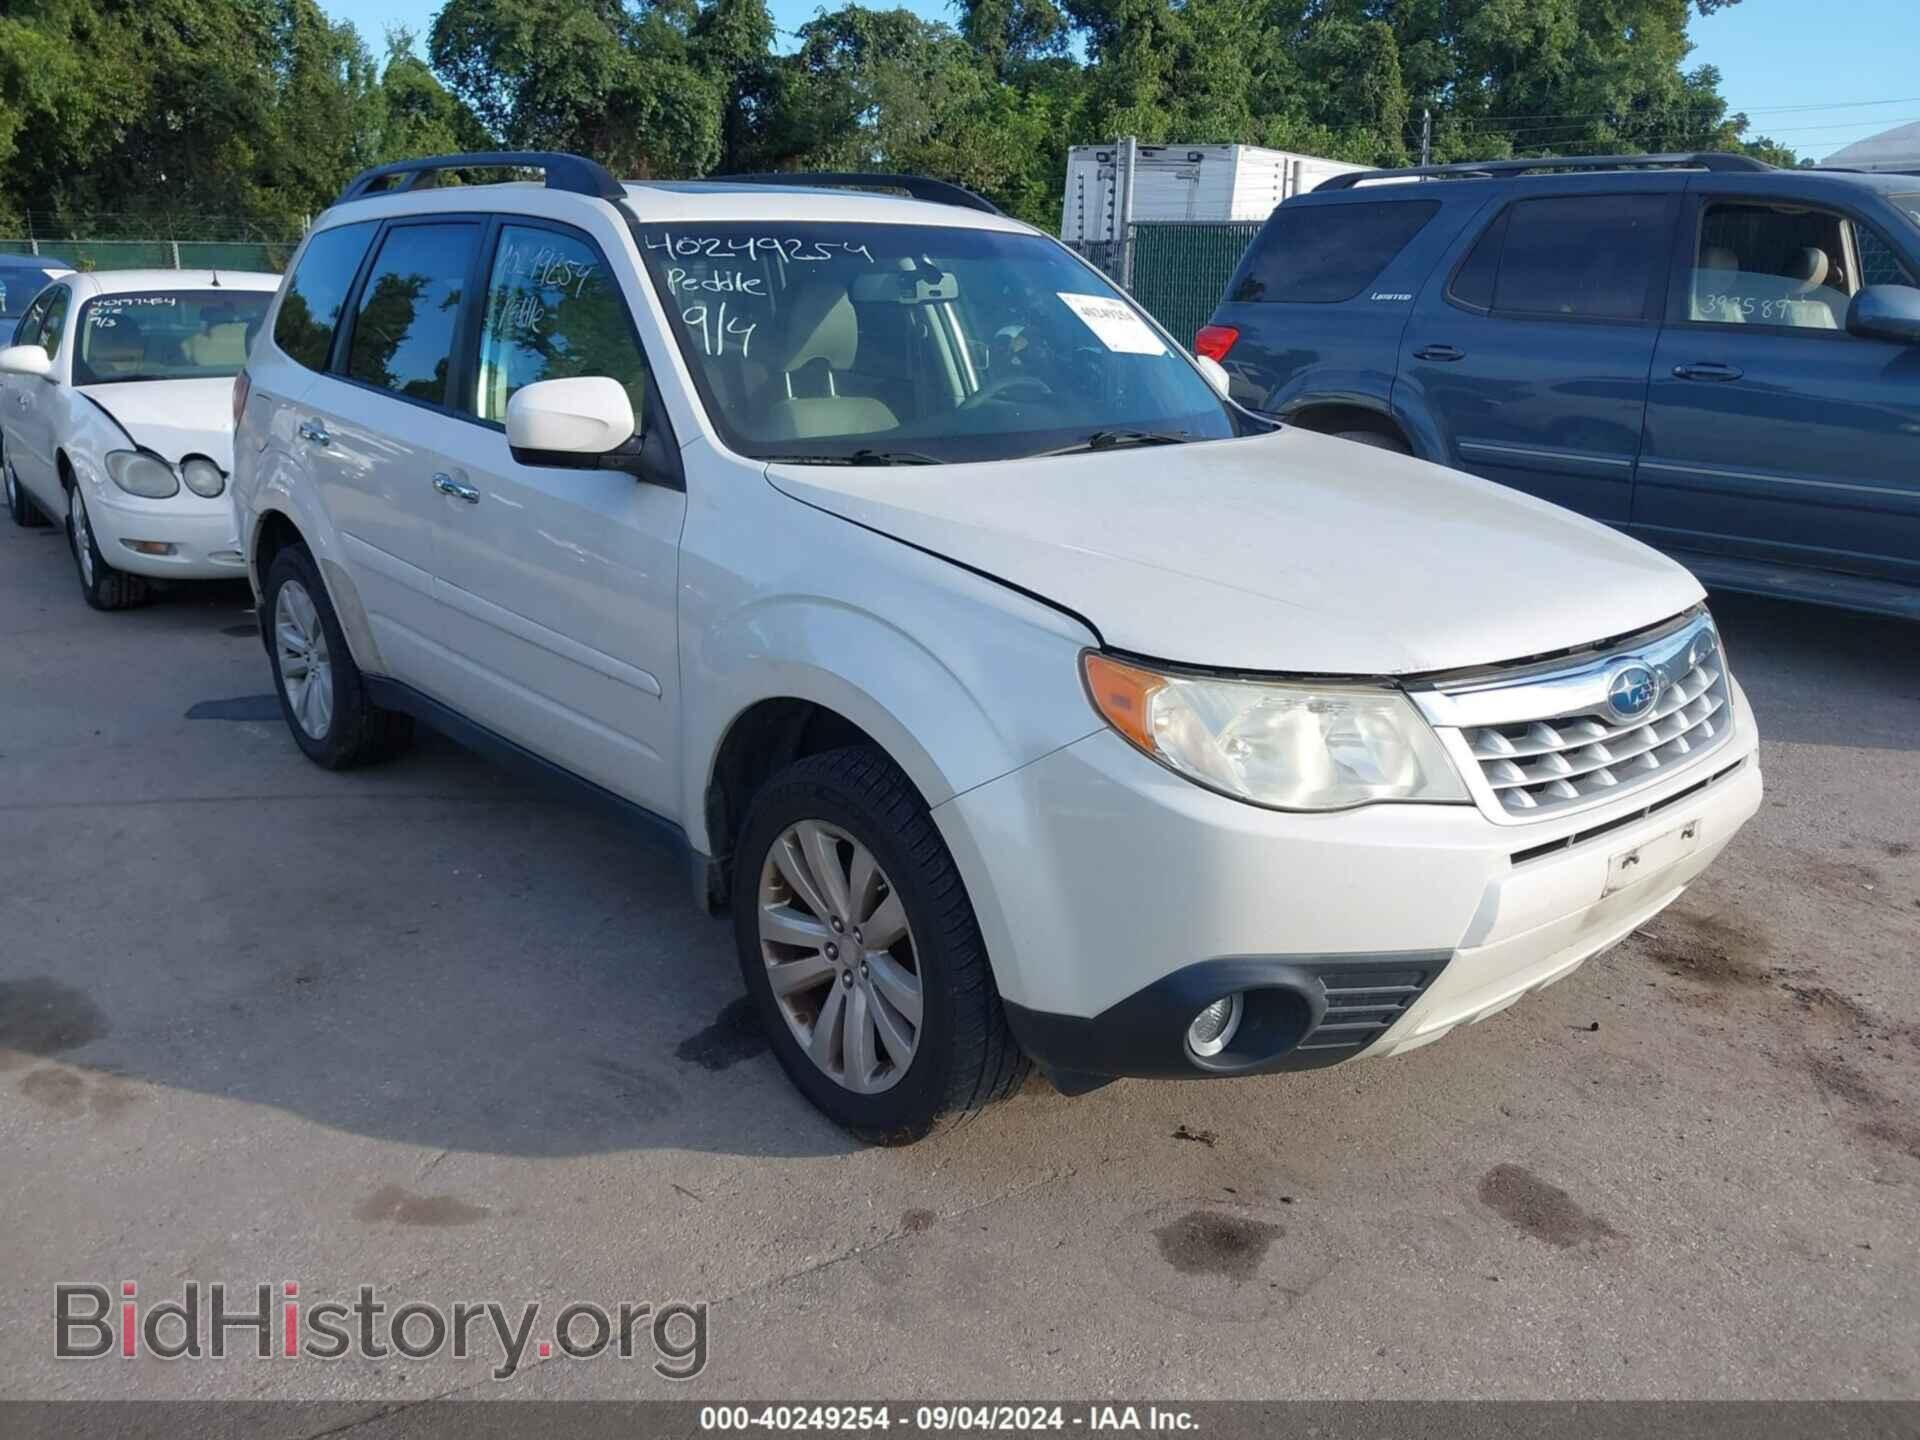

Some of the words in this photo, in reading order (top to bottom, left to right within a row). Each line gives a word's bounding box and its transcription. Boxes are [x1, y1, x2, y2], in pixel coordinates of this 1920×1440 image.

[645, 233, 874, 263] 40249254
[667, 268, 767, 296] Peddle
[682, 302, 757, 358] 9/4
